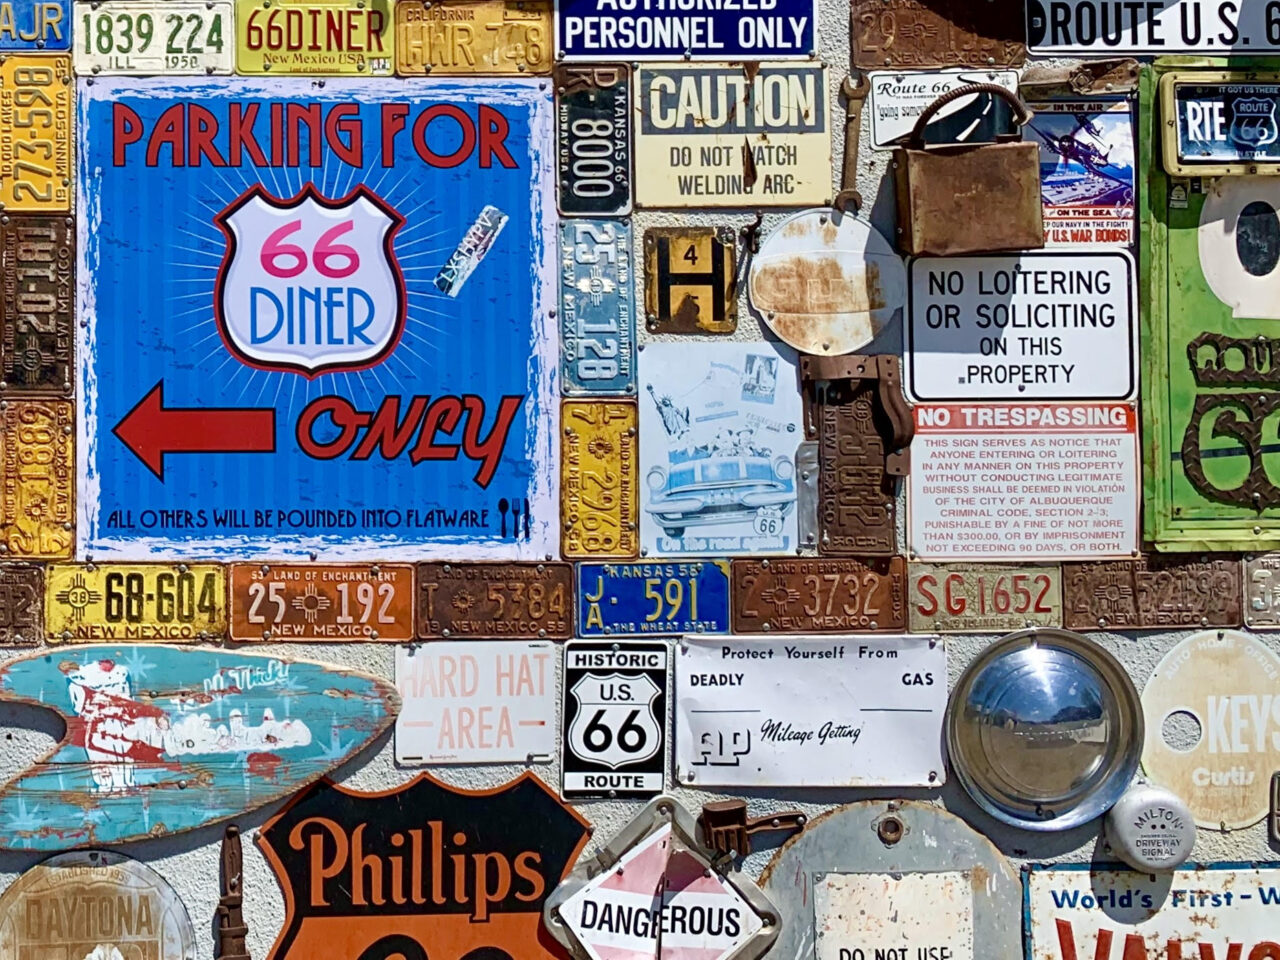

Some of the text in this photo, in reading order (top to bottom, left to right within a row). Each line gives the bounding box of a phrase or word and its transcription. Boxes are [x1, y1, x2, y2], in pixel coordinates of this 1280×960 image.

[83, 13, 224, 55] 1839 224
[247, 8, 384, 53] 66DINER
[565, 16, 807, 50] PERSONNEL ONLY
[1051, 0, 1163, 48] ROUTE
[1180, 1, 1251, 48] U.S.
[263, 52, 366, 65] New Mexico USA
[649, 74, 817, 130] CAUTION
[877, 81, 951, 99] Route 66
[1052, 103, 1104, 112] IN THE AIR
[13, 67, 55, 203] 273-598
[111, 102, 520, 171] PARKING FOR
[259, 218, 362, 280] 66
[928, 270, 1112, 296] NO LOITERING
[248, 286, 377, 346] DINER
[925, 303, 1116, 329] OR SOLICITING
[979, 336, 1063, 357] ON THIS
[966, 364, 1076, 385] PROPERTY
[918, 406, 1128, 427] NO TRESPASSING
[295, 395, 526, 489] ONLY
[924, 438, 1122, 448] THIS SIGN SERVES AS NOTICE THAT
[107, 510, 490, 529] ALL OTHERS WILL BE POUNDED INTO FLATWARE
[105, 572, 216, 625] 68-604
[574, 652, 660, 669] HISTORIC
[721, 645, 898, 662] Protect Yourself From
[599, 682, 636, 703] U.S.
[690, 673, 935, 688] DEADLY GAS
[437, 705, 516, 751] AREA
[581, 709, 649, 755] 66
[583, 774, 646, 791] ROUTE
[1191, 766, 1255, 787] Curtis
[1133, 807, 1183, 831] MILTON
[1135, 839, 1182, 848] DRIVEWAY
[288, 815, 545, 924] Phillips
[1050, 888, 1234, 909] World's First
[26, 894, 154, 939] DAYTONA
[580, 899, 742, 940] DANGEROUS
